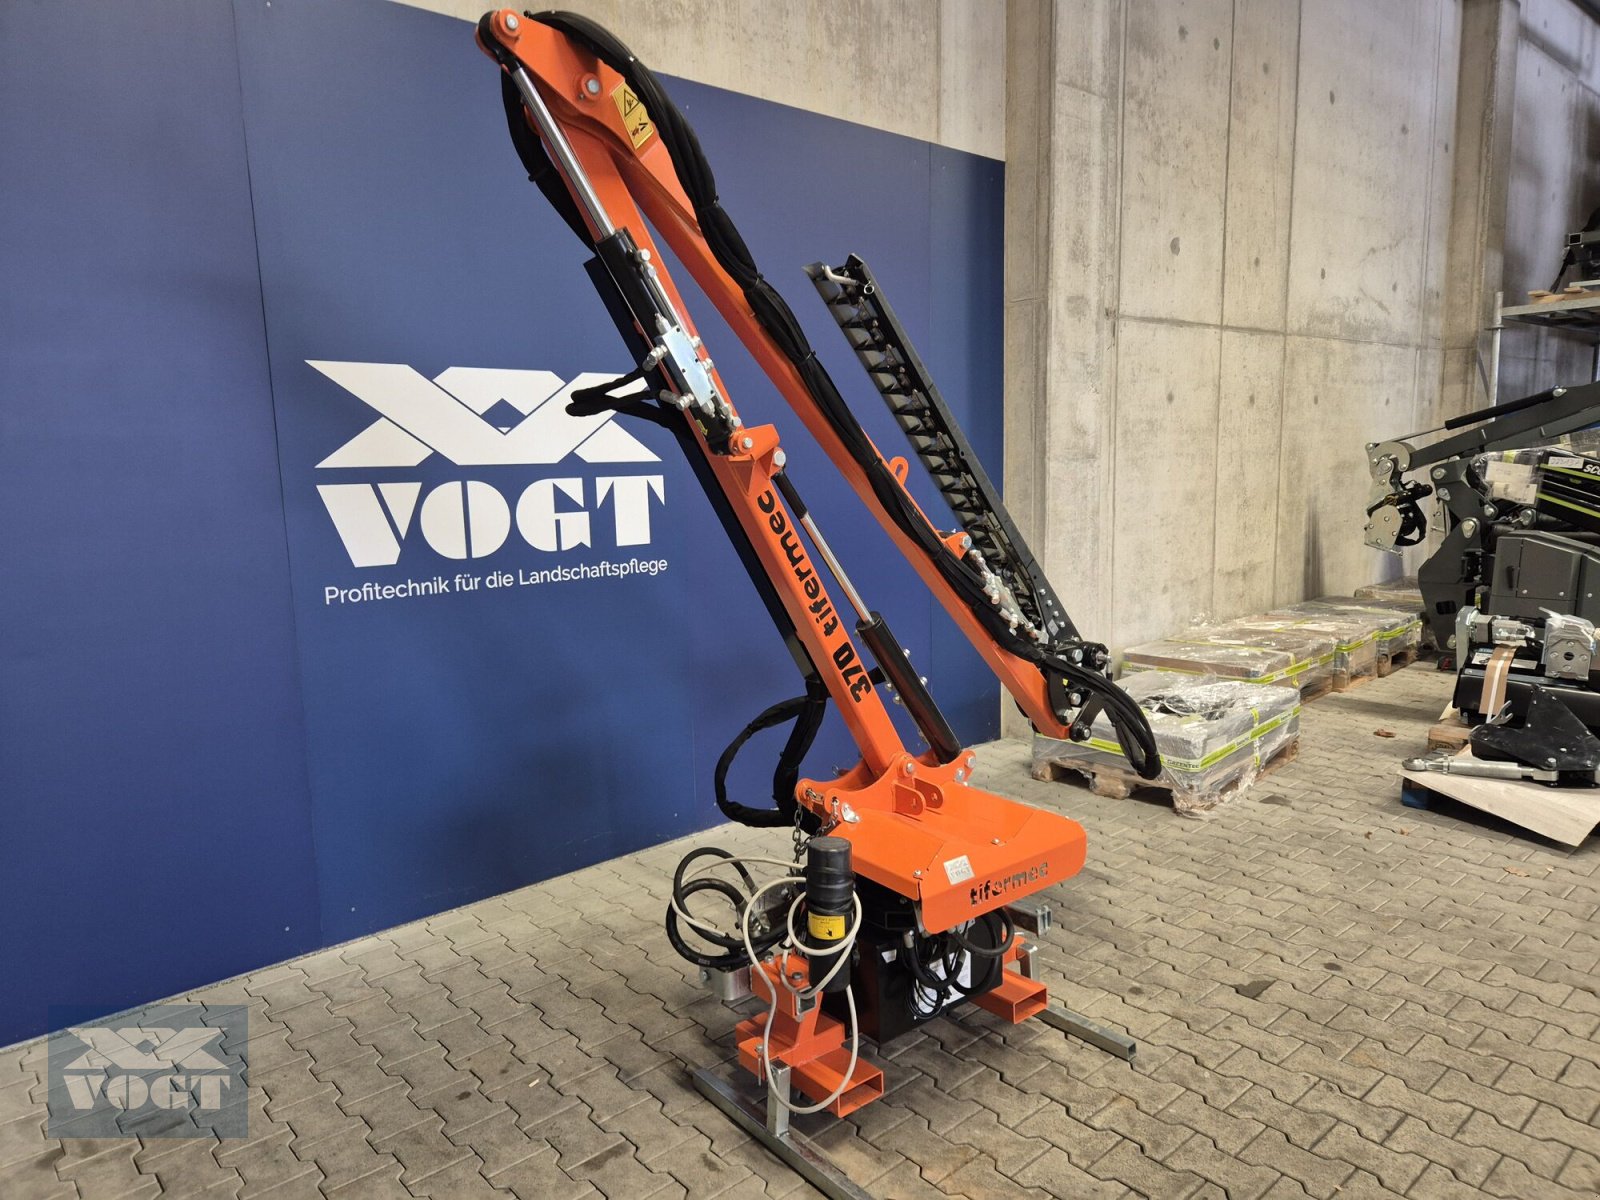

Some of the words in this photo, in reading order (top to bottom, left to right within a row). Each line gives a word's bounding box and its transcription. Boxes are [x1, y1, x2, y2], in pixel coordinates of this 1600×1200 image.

[316, 475, 665, 567] VOGT
[324, 575, 450, 604] Profitechnik
[454, 574, 480, 592] für
[485, 570, 514, 588] die
[519, 558, 668, 585] Landschaftspflege
[757, 490, 838, 637] tifermec
[833, 641, 872, 703] 370
[970, 862, 1048, 905] tifermec
